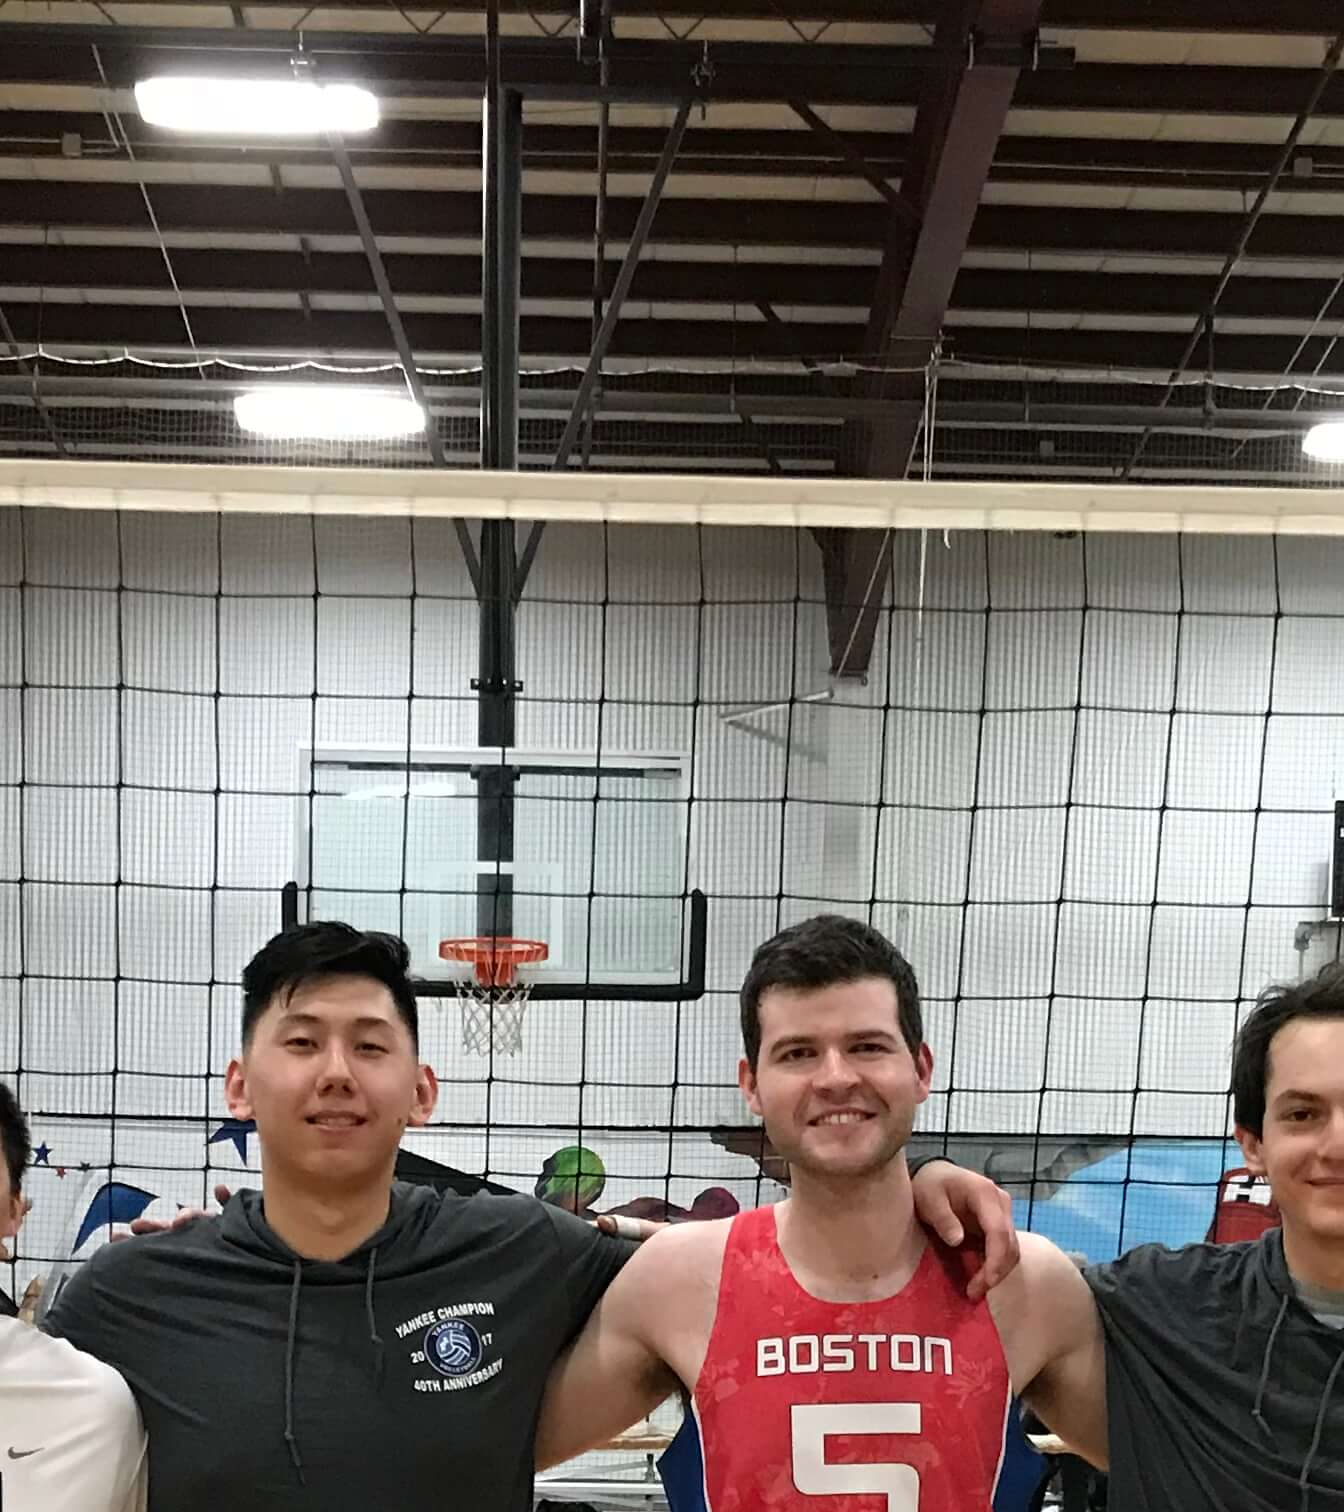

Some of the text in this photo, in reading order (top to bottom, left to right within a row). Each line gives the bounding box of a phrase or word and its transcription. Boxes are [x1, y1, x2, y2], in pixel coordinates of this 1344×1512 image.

[395, 1302, 495, 1339] YANKEE CHAMPION
[431, 1322, 465, 1337] YANKEE
[481, 1333, 494, 1347] 17
[410, 1350, 425, 1364] 20
[756, 1334, 953, 1377] BOSTON
[413, 1358, 504, 1393] 40TH ANNIVERSARY
